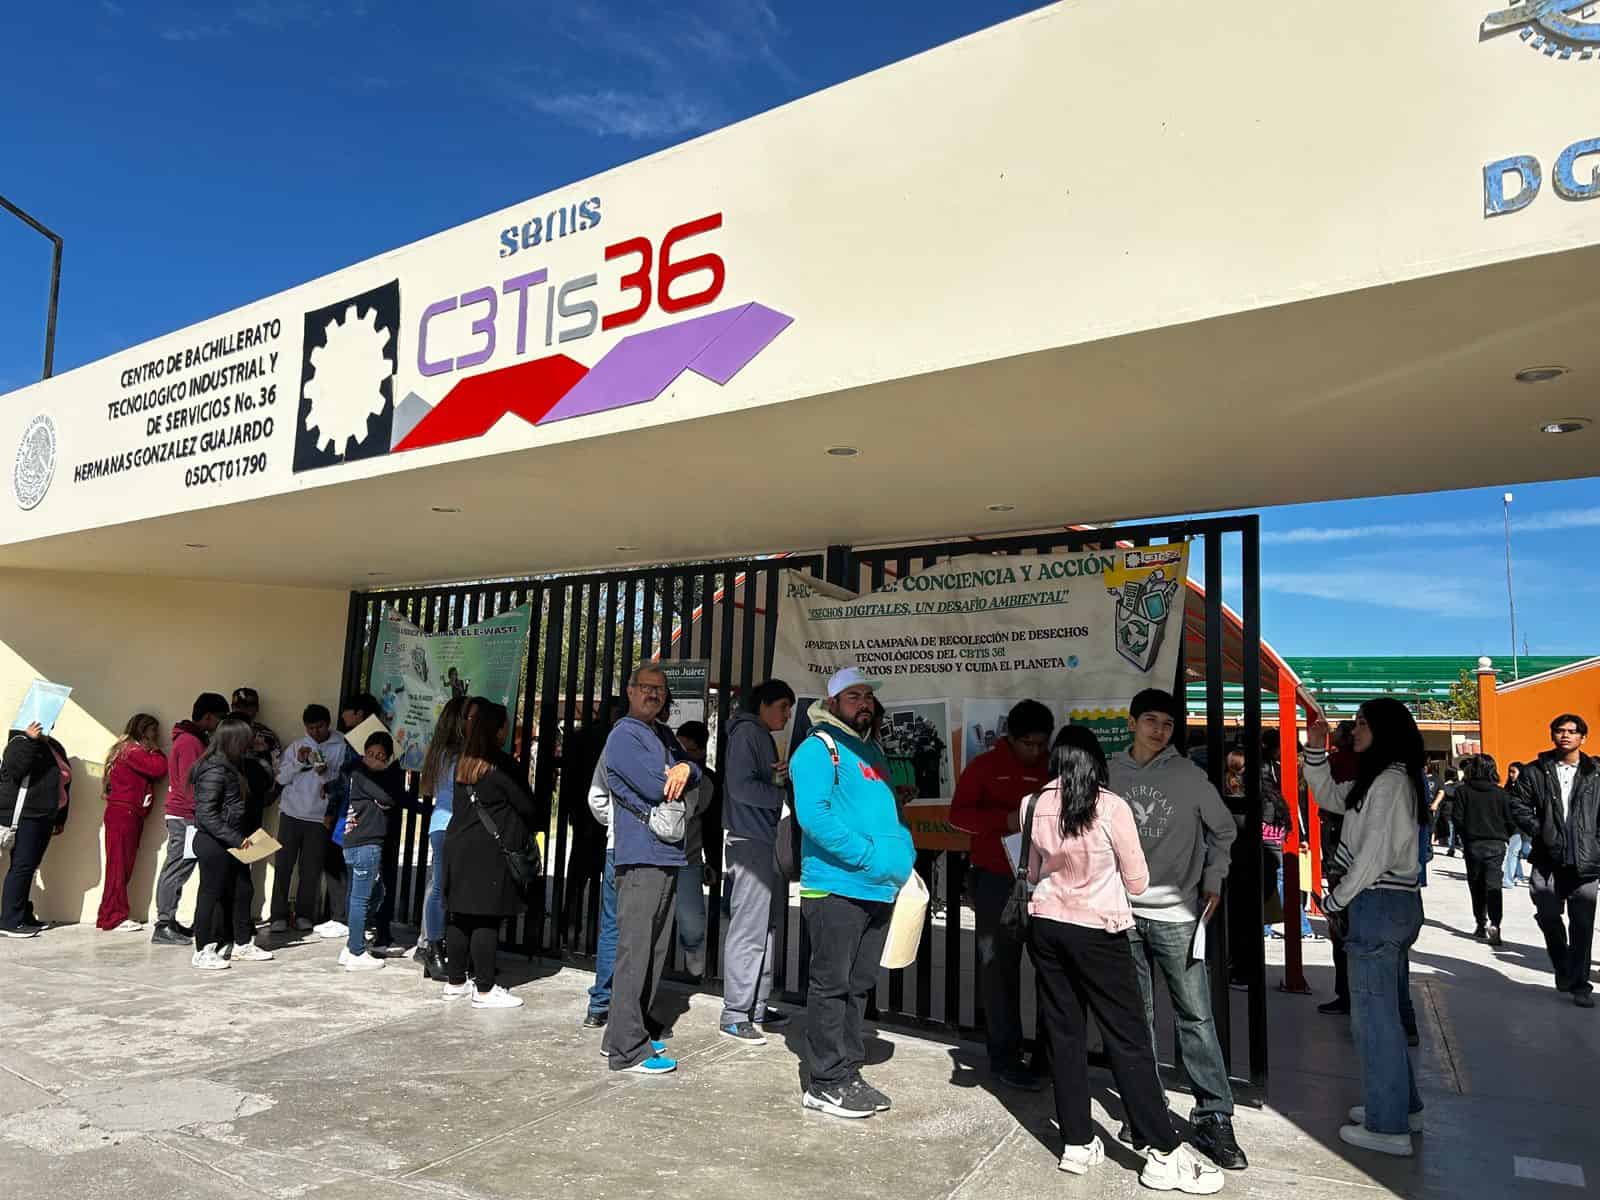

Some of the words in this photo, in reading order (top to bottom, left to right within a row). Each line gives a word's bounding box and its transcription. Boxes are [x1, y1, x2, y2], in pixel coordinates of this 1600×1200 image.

[121, 359, 164, 388] CENTRO
[167, 351, 182, 375] DE
[185, 318, 280, 368] BACHILLERATO
[107, 381, 186, 421] TECNOLOGICO
[189, 355, 265, 397] INDUSTRIAL
[270, 351, 278, 373] Y
[146, 415, 162, 436] DE
[165, 396, 230, 432] SERVICIOS
[259, 384, 277, 407] 36
[74, 452, 133, 483] HERMANAS
[134, 435, 198, 467] GONZALEZ
[200, 416, 274, 452] GUAJARDO
[184, 452, 267, 488] 05DCT01790
[903, 566, 1016, 592] CONCIENCIA
[1020, 564, 1033, 581] Y
[1039, 553, 1116, 581] ACCIÓN
[845, 602, 912, 617] DIGITALES,
[915, 601, 935, 613] UN
[940, 597, 987, 612] DESAFÍO
[852, 638, 865, 649] LA
[866, 634, 919, 649] CAMPAÑA
[921, 634, 936, 646] DE
[939, 630, 1009, 646] RECOLECCIÓN
[1011, 630, 1026, 641] DE
[1028, 626, 1089, 640] DESECHOS
[855, 649, 934, 662] TECNOLÓGICOS
[937, 649, 957, 660] DEL
[894, 663, 909, 673] EN
[910, 662, 953, 674] DESUSO
[954, 661, 962, 672] Y
[965, 660, 998, 673] CUIDA
[1000, 659, 1012, 671] EL
[1014, 657, 1065, 671] PLANETA
